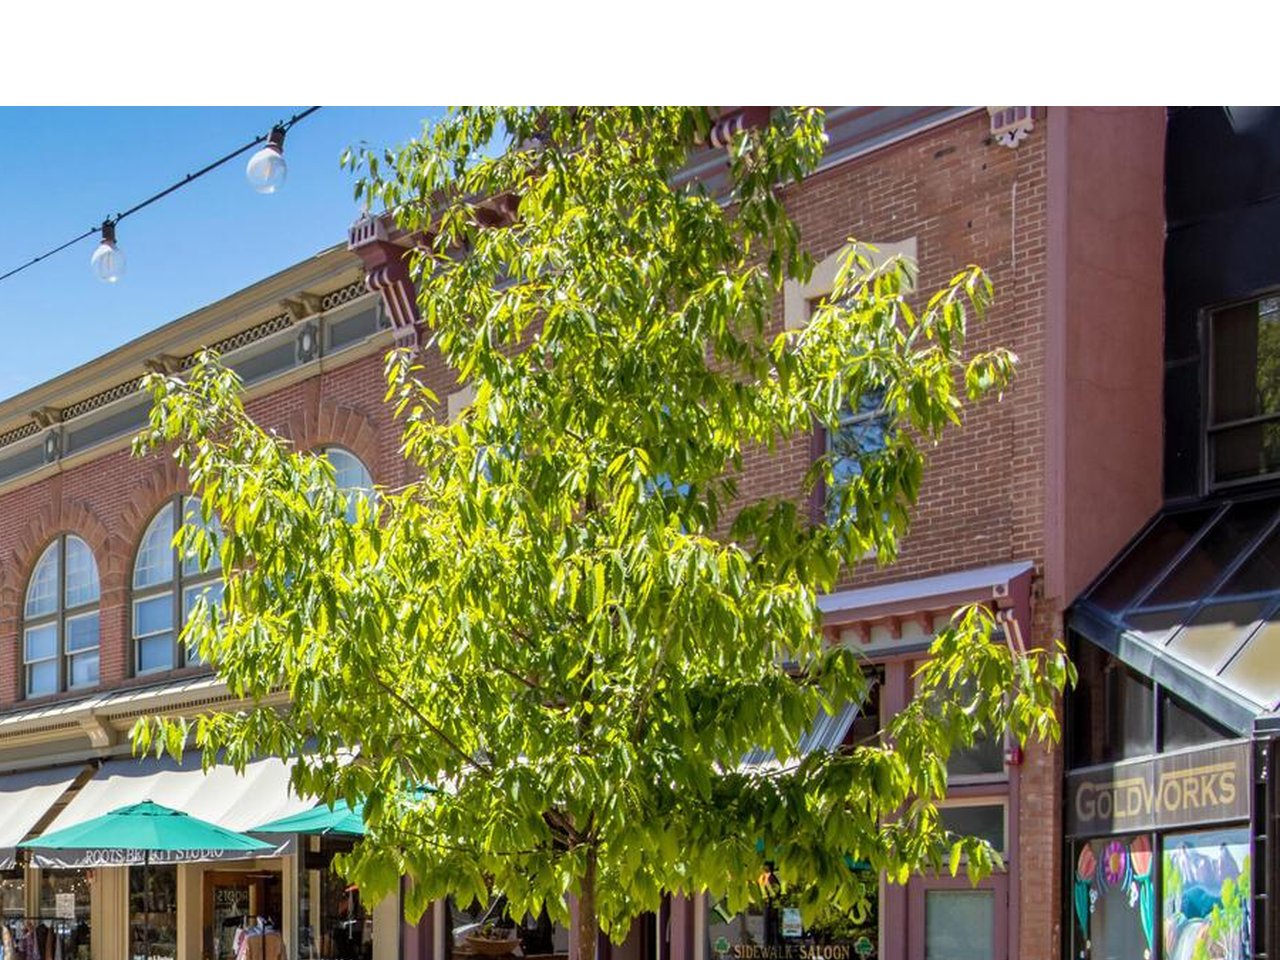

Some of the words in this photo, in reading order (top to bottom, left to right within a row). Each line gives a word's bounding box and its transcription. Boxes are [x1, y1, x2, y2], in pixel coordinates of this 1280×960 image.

[85, 849, 124, 863] ROOTS
[175, 847, 224, 861] STUDIO
[733, 944, 795, 960] SIDEWALK
[799, 944, 850, 960] SALOON
